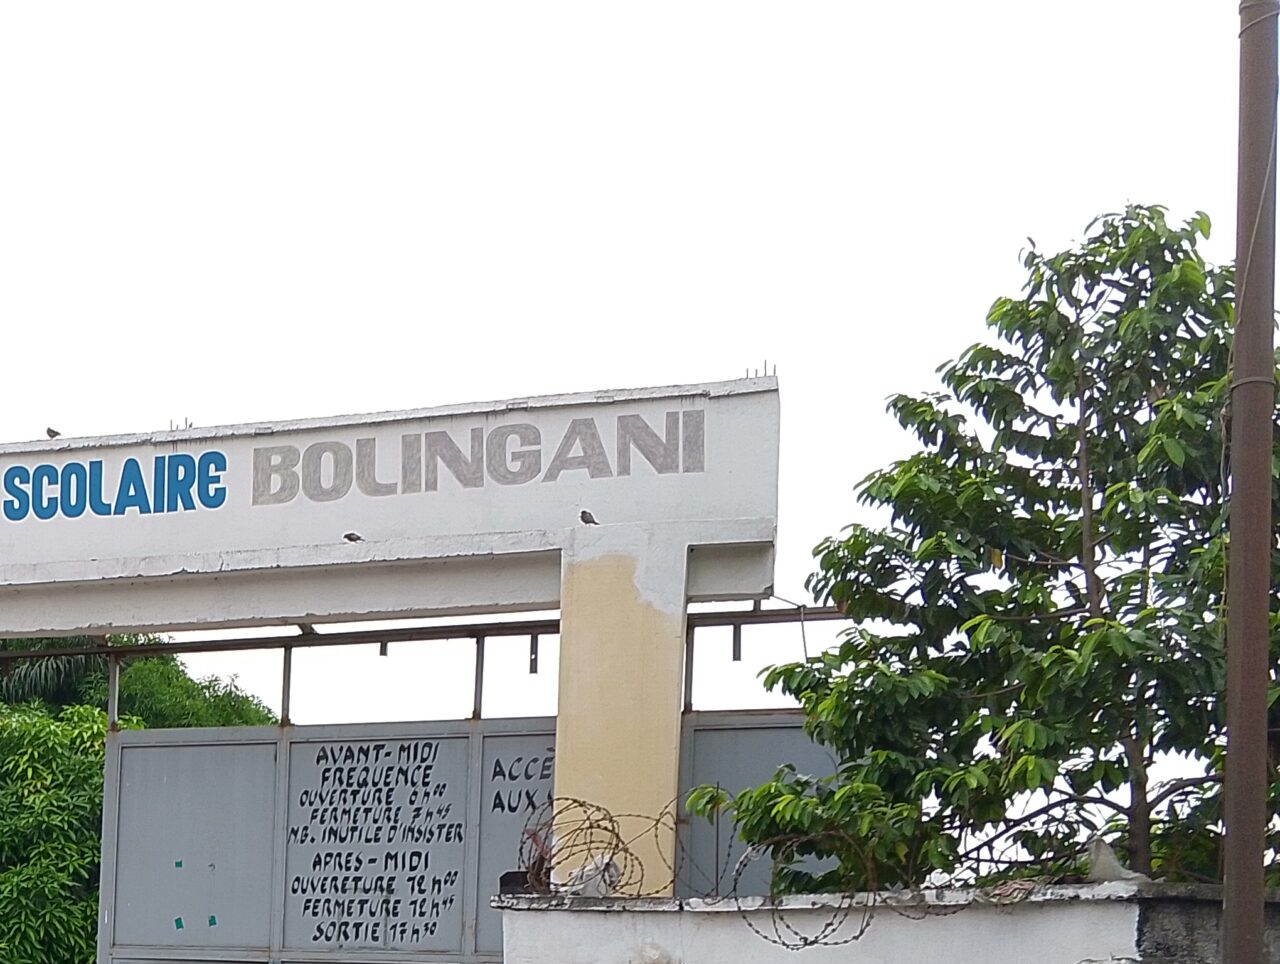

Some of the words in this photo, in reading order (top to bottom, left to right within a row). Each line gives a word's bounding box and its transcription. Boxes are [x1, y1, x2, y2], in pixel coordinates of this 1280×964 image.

[3, 450, 228, 522] SCOLAIRE
[251, 409, 706, 507] BOLINGANI
[321, 765, 433, 788] FREQUENCE
[299, 788, 395, 807] OUVERTURE
[491, 789, 538, 814] AUX
[310, 806, 402, 825] FERMETURE
[321, 825, 383, 844] INUTILE
[386, 823, 463, 844] D'INSISTER
[291, 876, 396, 895] OUVERETURE
[302, 899, 401, 918] FERMETURE
[312, 921, 380, 943] SORTIE
